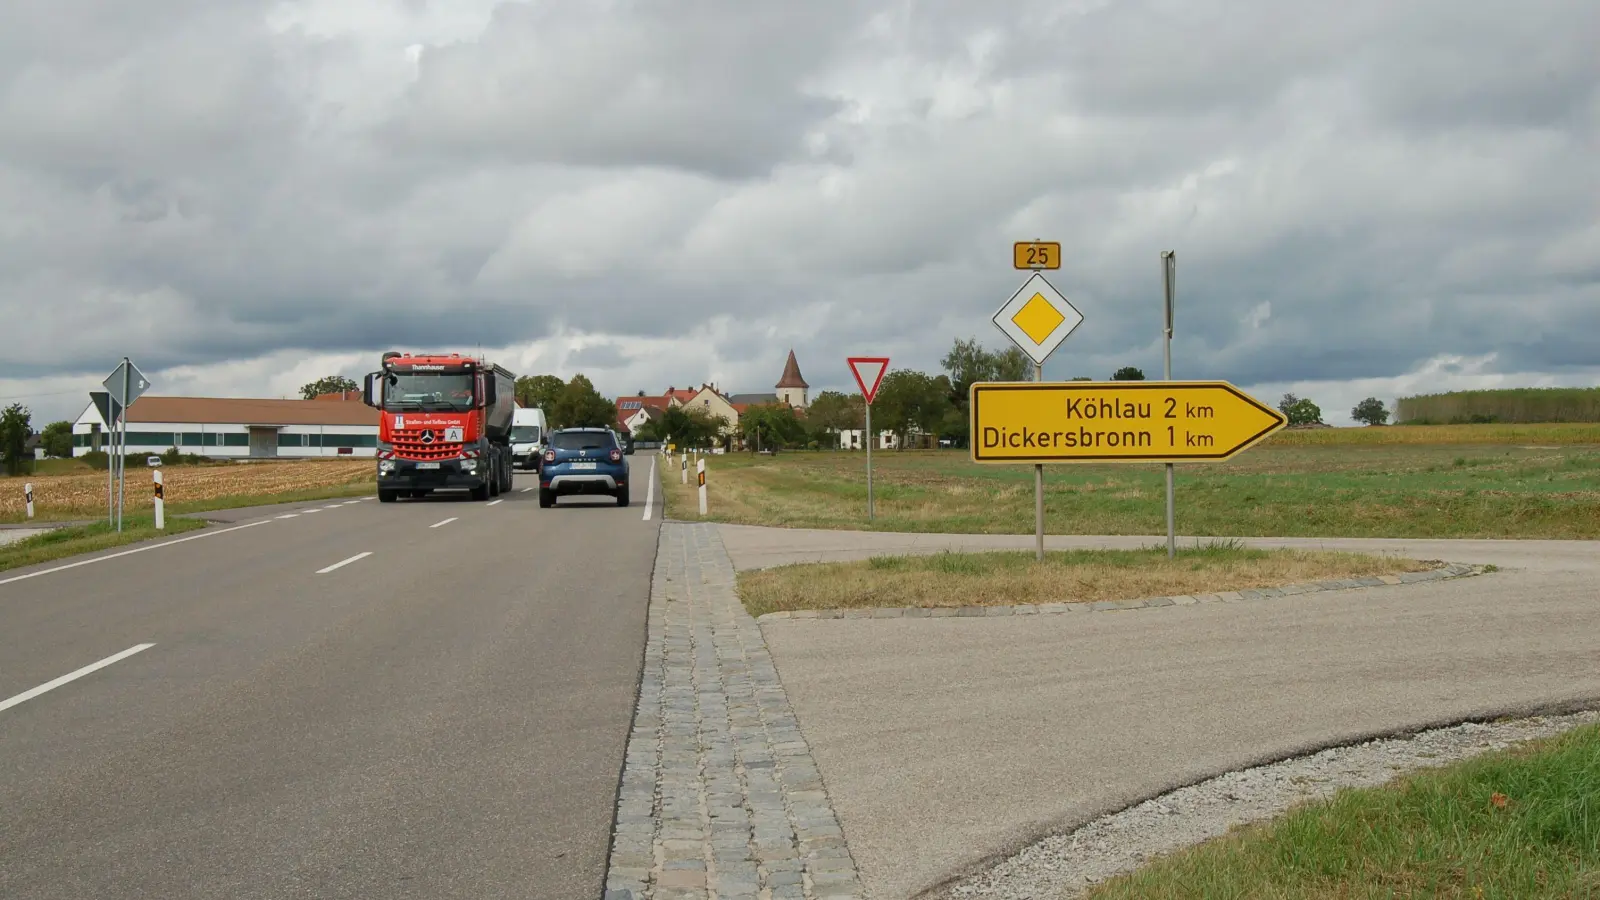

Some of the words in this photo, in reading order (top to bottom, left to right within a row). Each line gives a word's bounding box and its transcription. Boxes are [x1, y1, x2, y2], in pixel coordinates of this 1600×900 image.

[1026, 247, 1048, 265] 25
[1066, 397, 1152, 419] Köhlau
[1164, 397, 1177, 419] 2
[1185, 402, 1214, 419] km
[450, 430, 458, 440] A
[983, 426, 1151, 448] Dickersbronn
[1167, 426, 1175, 447] 1
[1185, 431, 1214, 447] km
